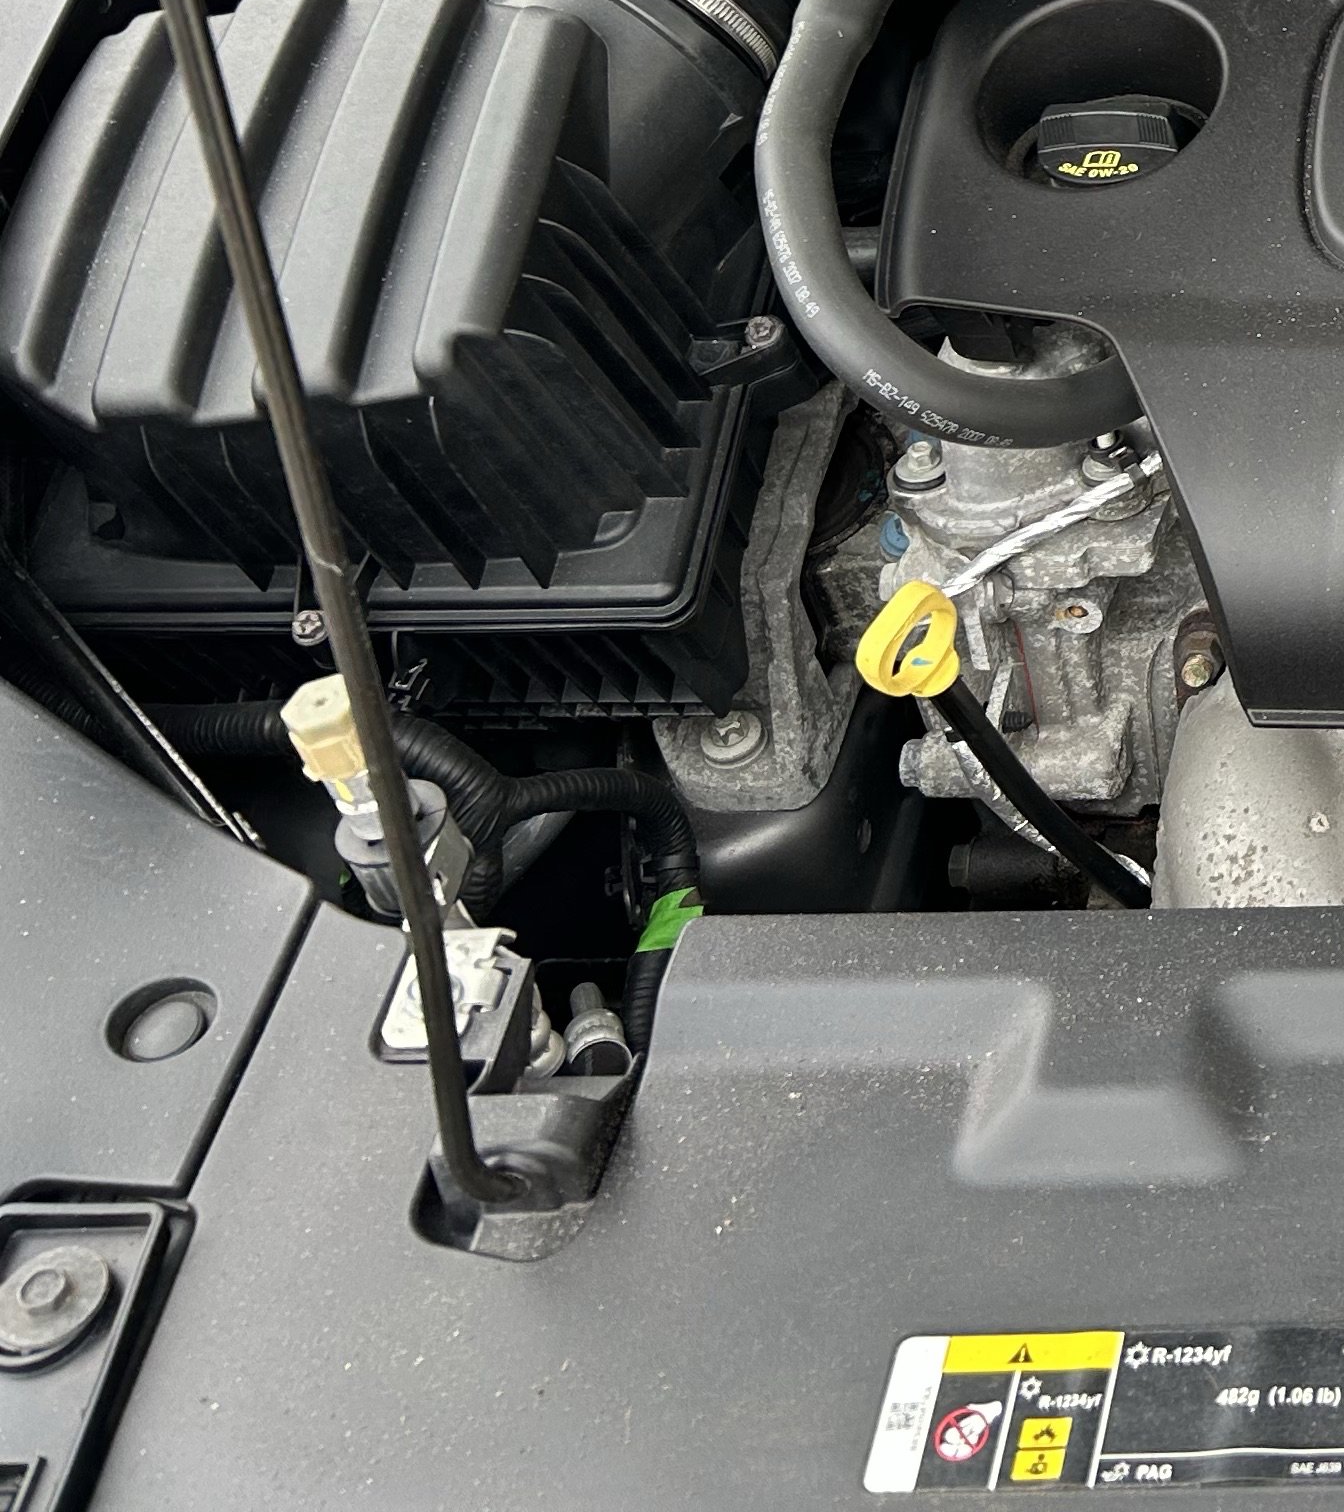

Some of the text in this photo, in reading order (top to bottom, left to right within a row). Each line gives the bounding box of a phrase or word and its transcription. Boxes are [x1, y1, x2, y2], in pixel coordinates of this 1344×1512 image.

[1058, 162, 1139, 178] SAE 0W-20
[1151, 1344, 1233, 1366] R-1234yf
[1038, 1392, 1103, 1411] R-1234yf
[1214, 1386, 1342, 1408] 482g (1.06 lb)
[1135, 1464, 1173, 1481] PAG
